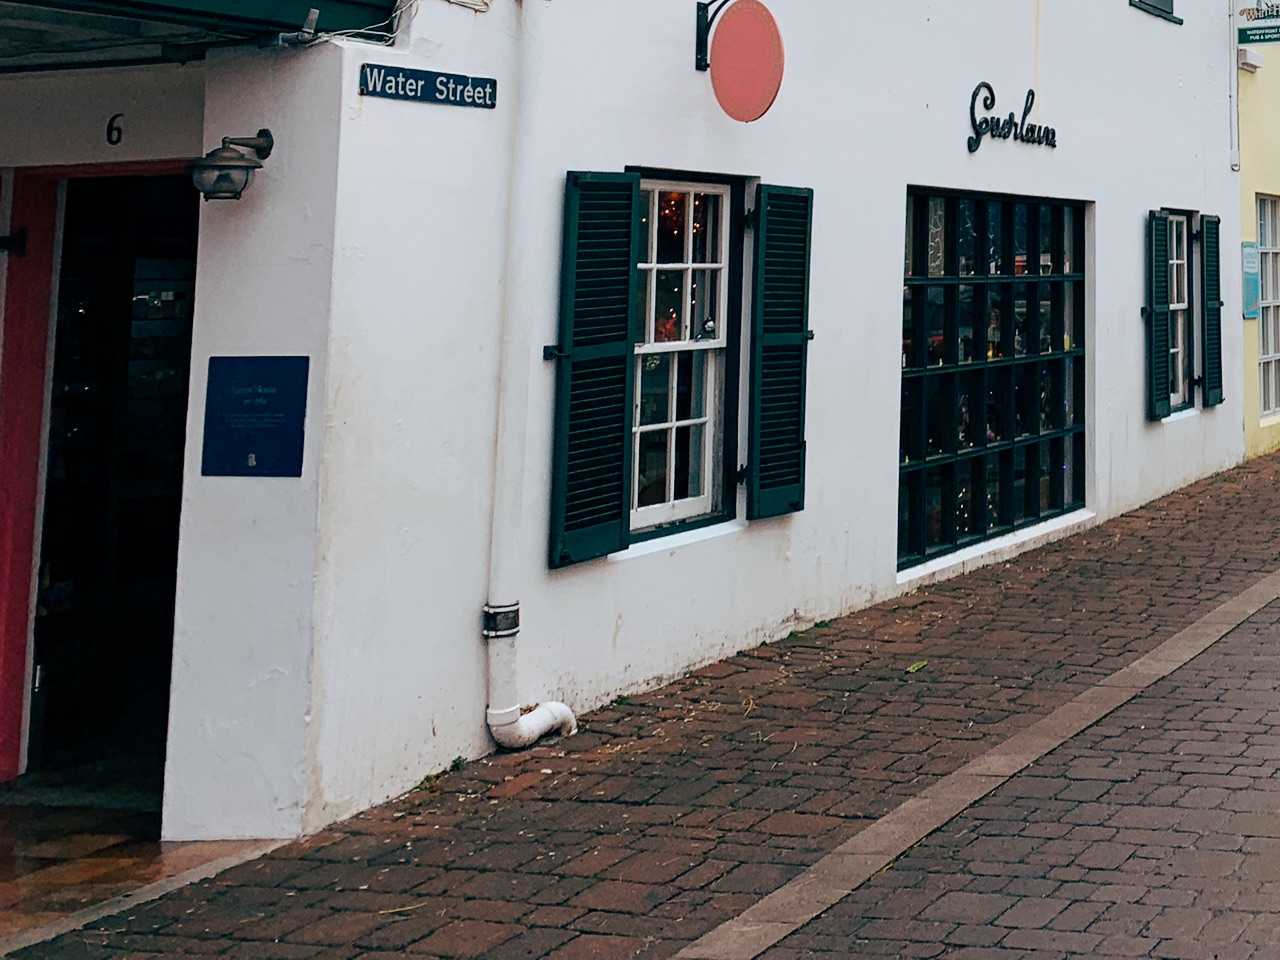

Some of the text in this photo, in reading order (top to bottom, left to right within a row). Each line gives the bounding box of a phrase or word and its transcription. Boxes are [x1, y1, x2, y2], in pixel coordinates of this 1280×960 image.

[366, 67, 492, 105] Water Street
[106, 113, 125, 146] 6
[967, 81, 1057, 153] Guerlain
